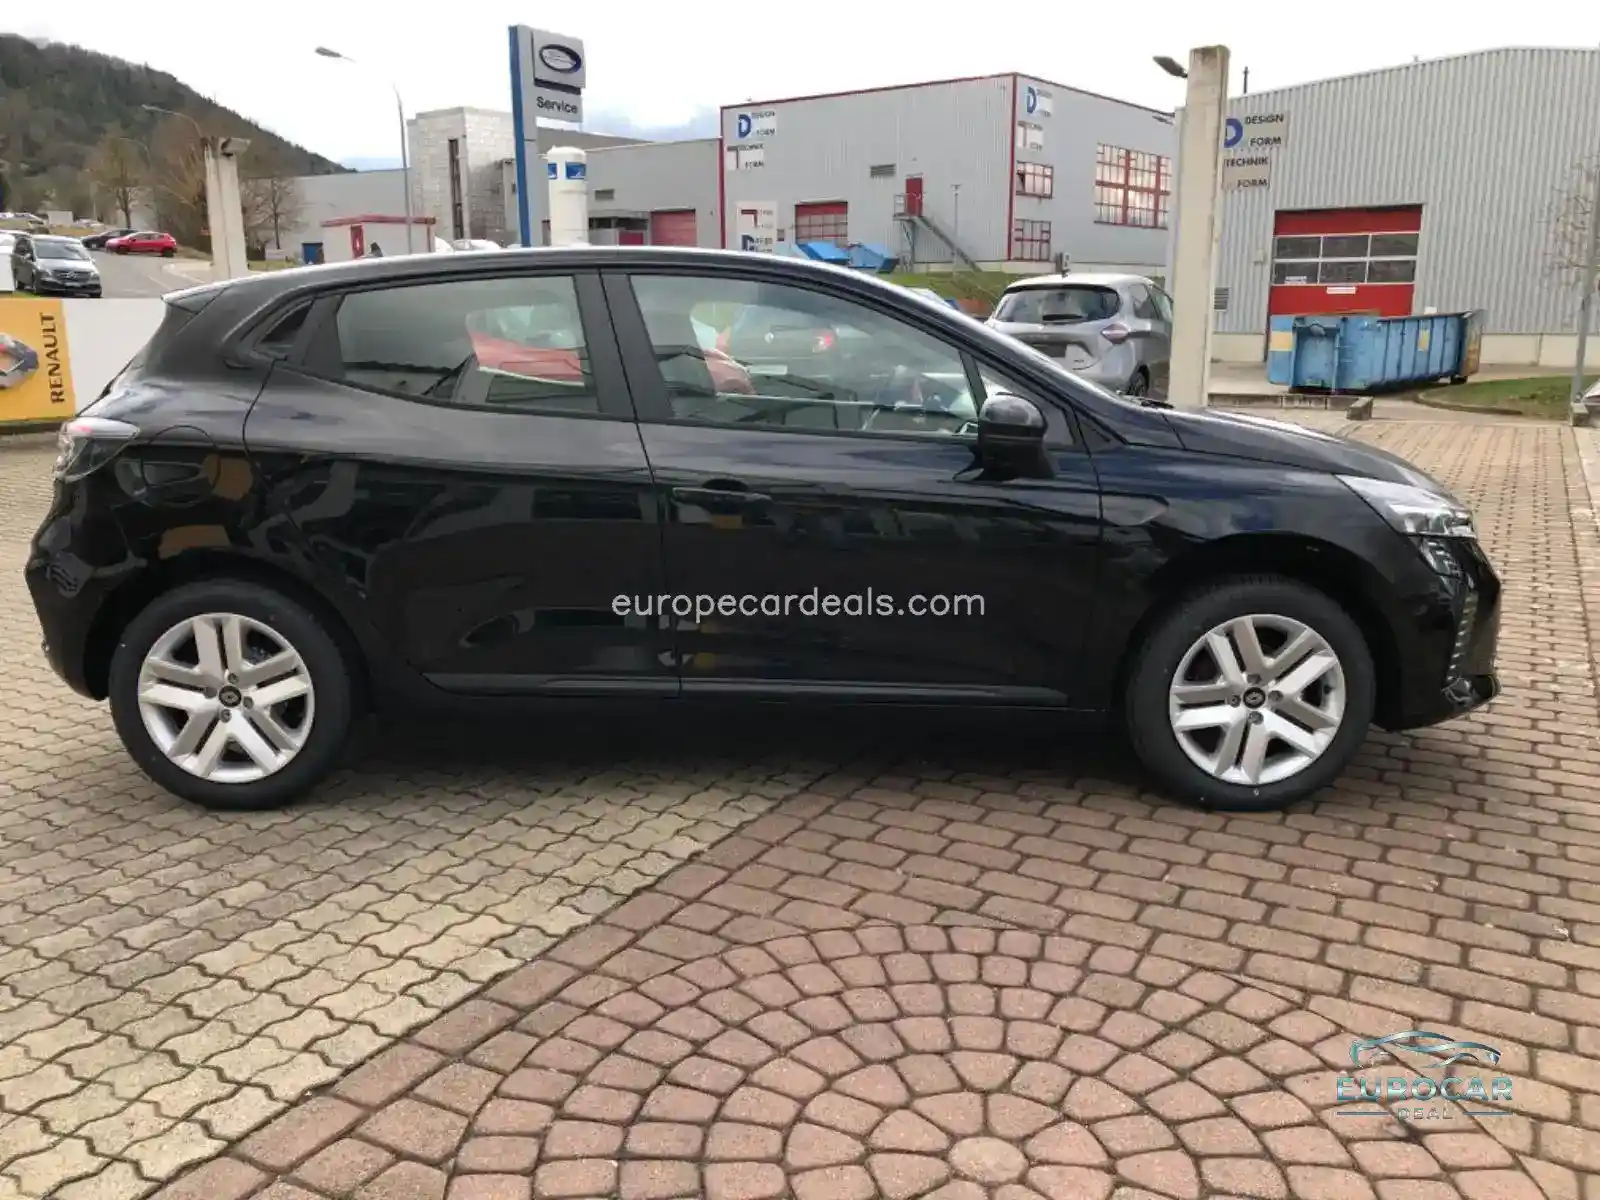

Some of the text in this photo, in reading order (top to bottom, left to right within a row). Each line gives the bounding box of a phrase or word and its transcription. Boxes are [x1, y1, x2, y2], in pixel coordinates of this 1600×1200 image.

[536, 96, 578, 114] Service
[738, 113, 752, 138] D
[1245, 114, 1284, 124] DESIGN
[1224, 118, 1243, 148] D
[1250, 136, 1281, 146] FORM
[1225, 157, 1268, 167] TECHNIK
[39, 312, 65, 404] RENAULT
